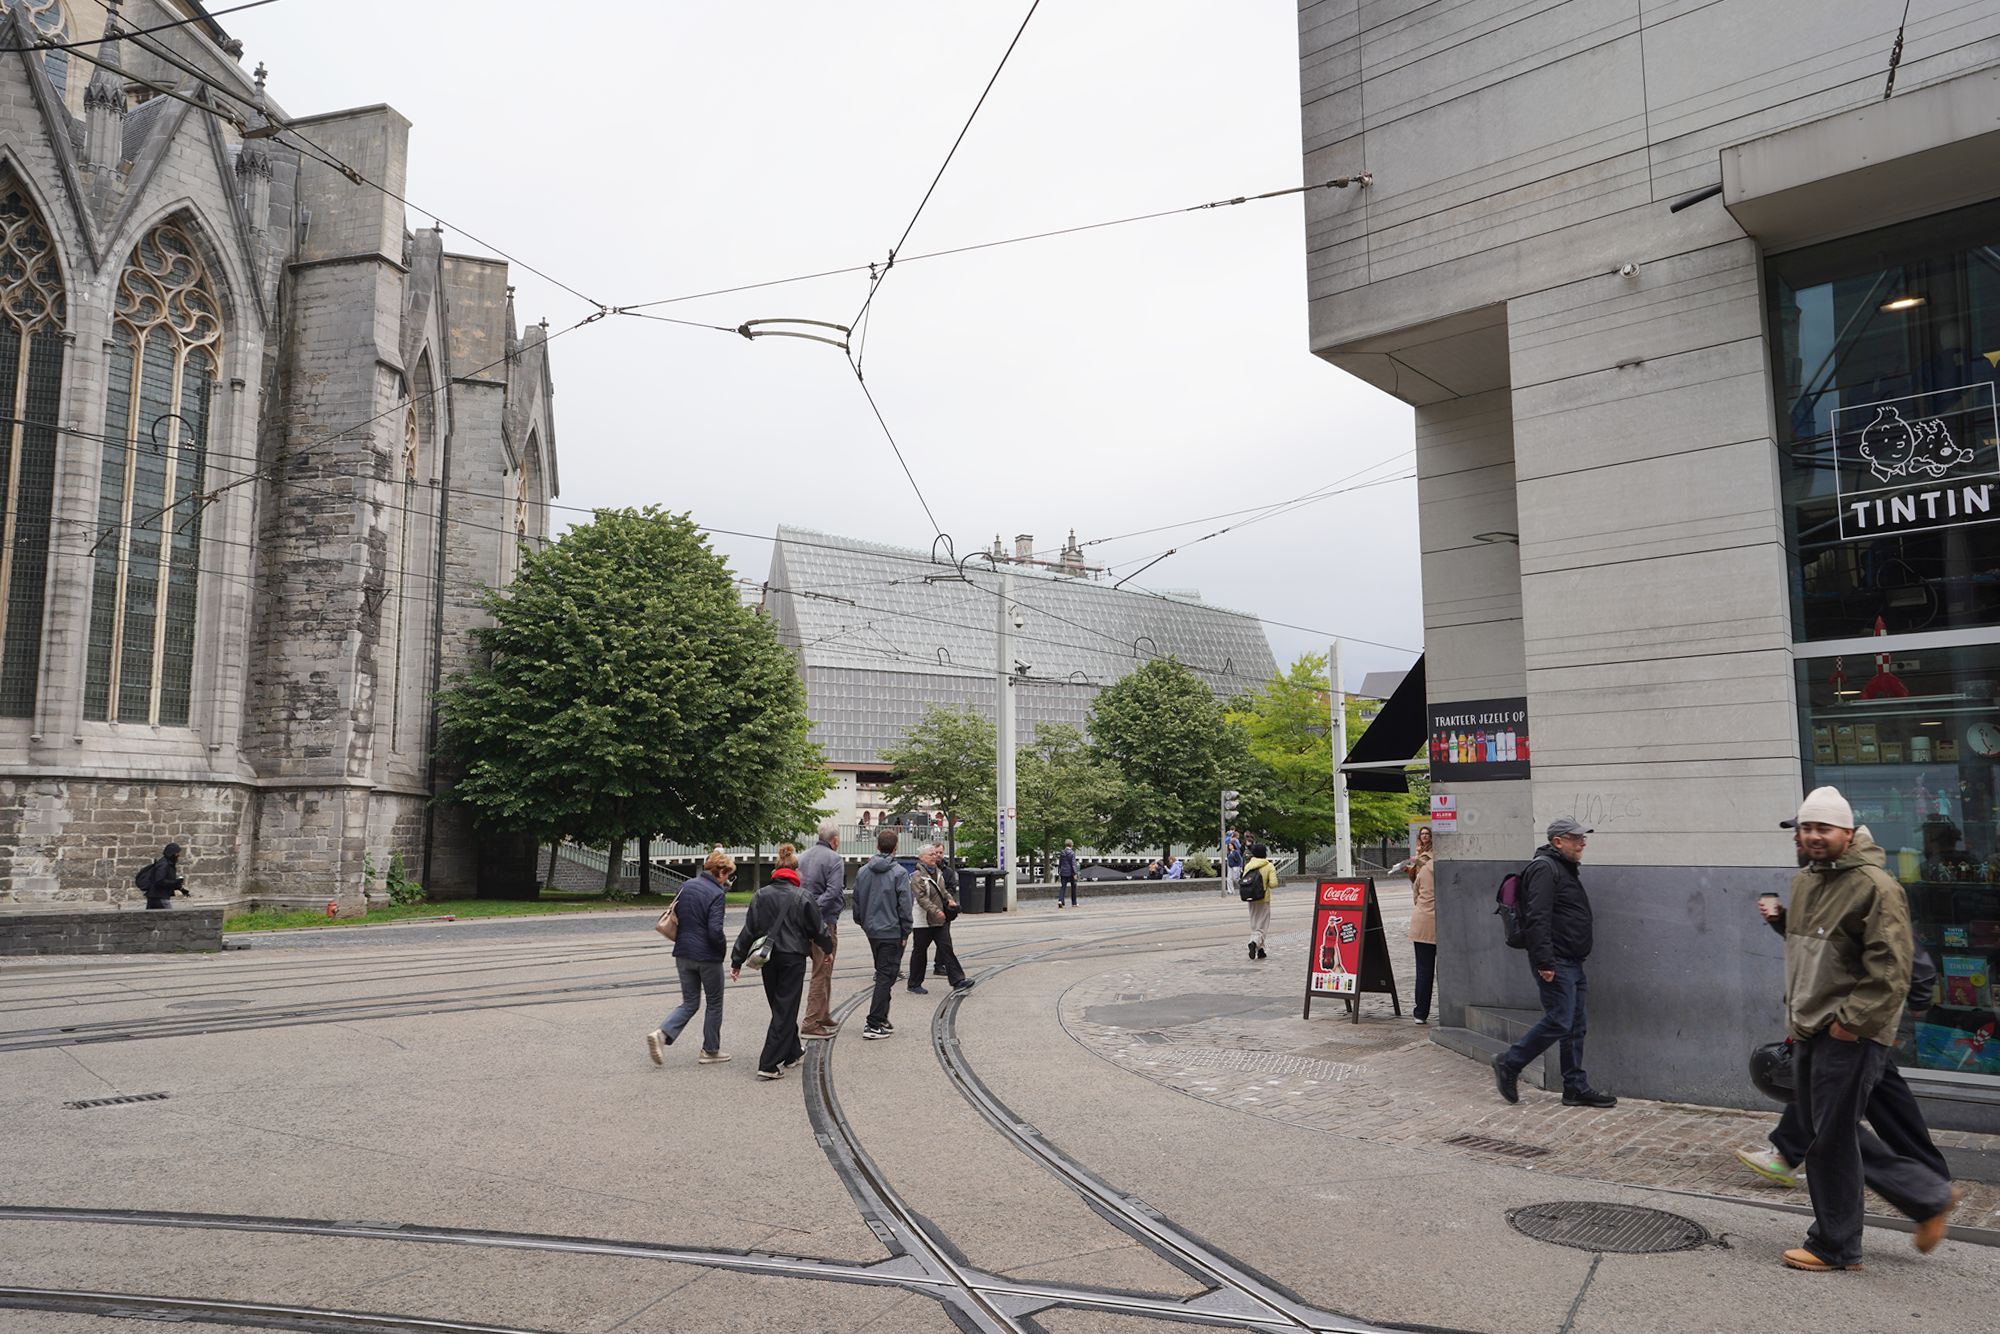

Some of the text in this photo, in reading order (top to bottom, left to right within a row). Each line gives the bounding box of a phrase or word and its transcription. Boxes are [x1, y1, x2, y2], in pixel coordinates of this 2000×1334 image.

[1850, 484, 1990, 528] TINTIN
[1435, 710, 1526, 727] TRAKTEER JEZELF OP
